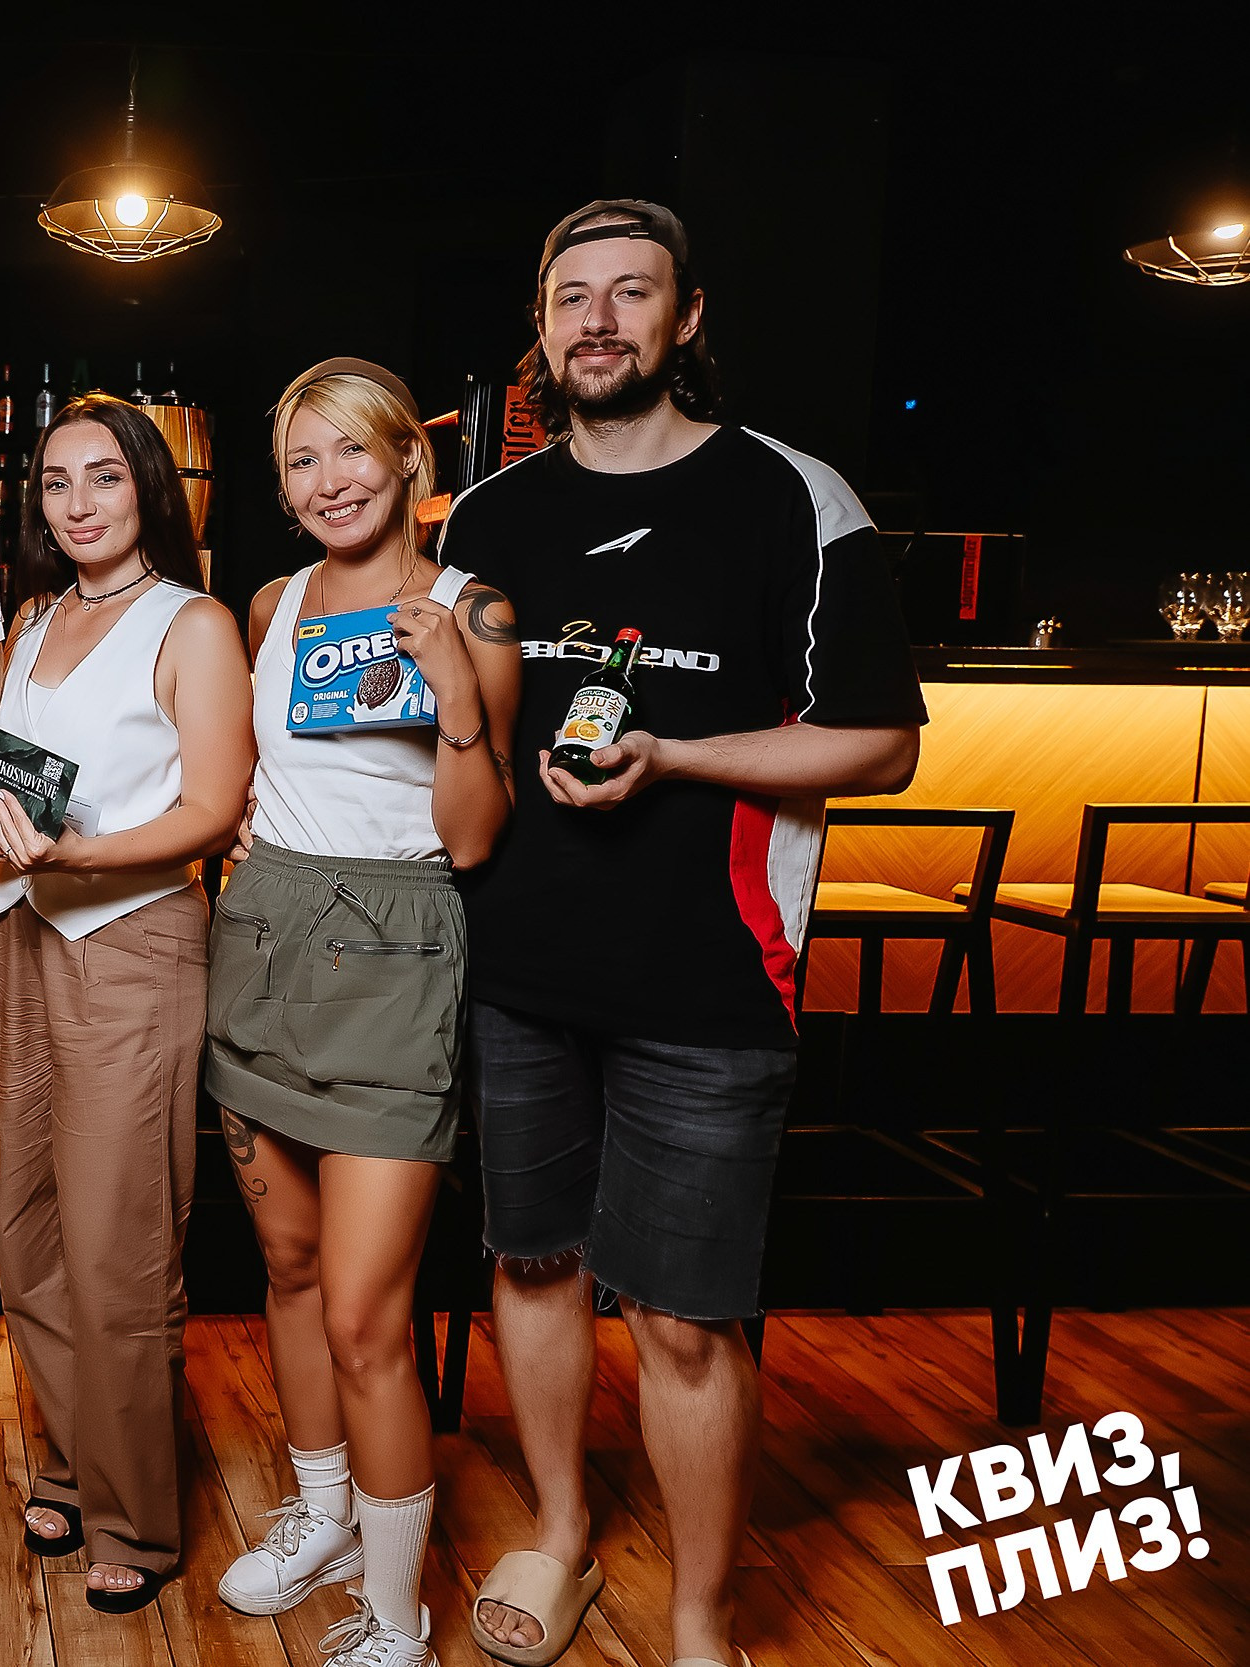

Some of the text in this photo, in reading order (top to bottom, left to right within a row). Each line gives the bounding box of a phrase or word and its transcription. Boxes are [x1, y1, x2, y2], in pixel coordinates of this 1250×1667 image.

[305, 633, 399, 679] ORE
[313, 690, 349, 702] ORIGINAL
[573, 697, 607, 707] SOJU
